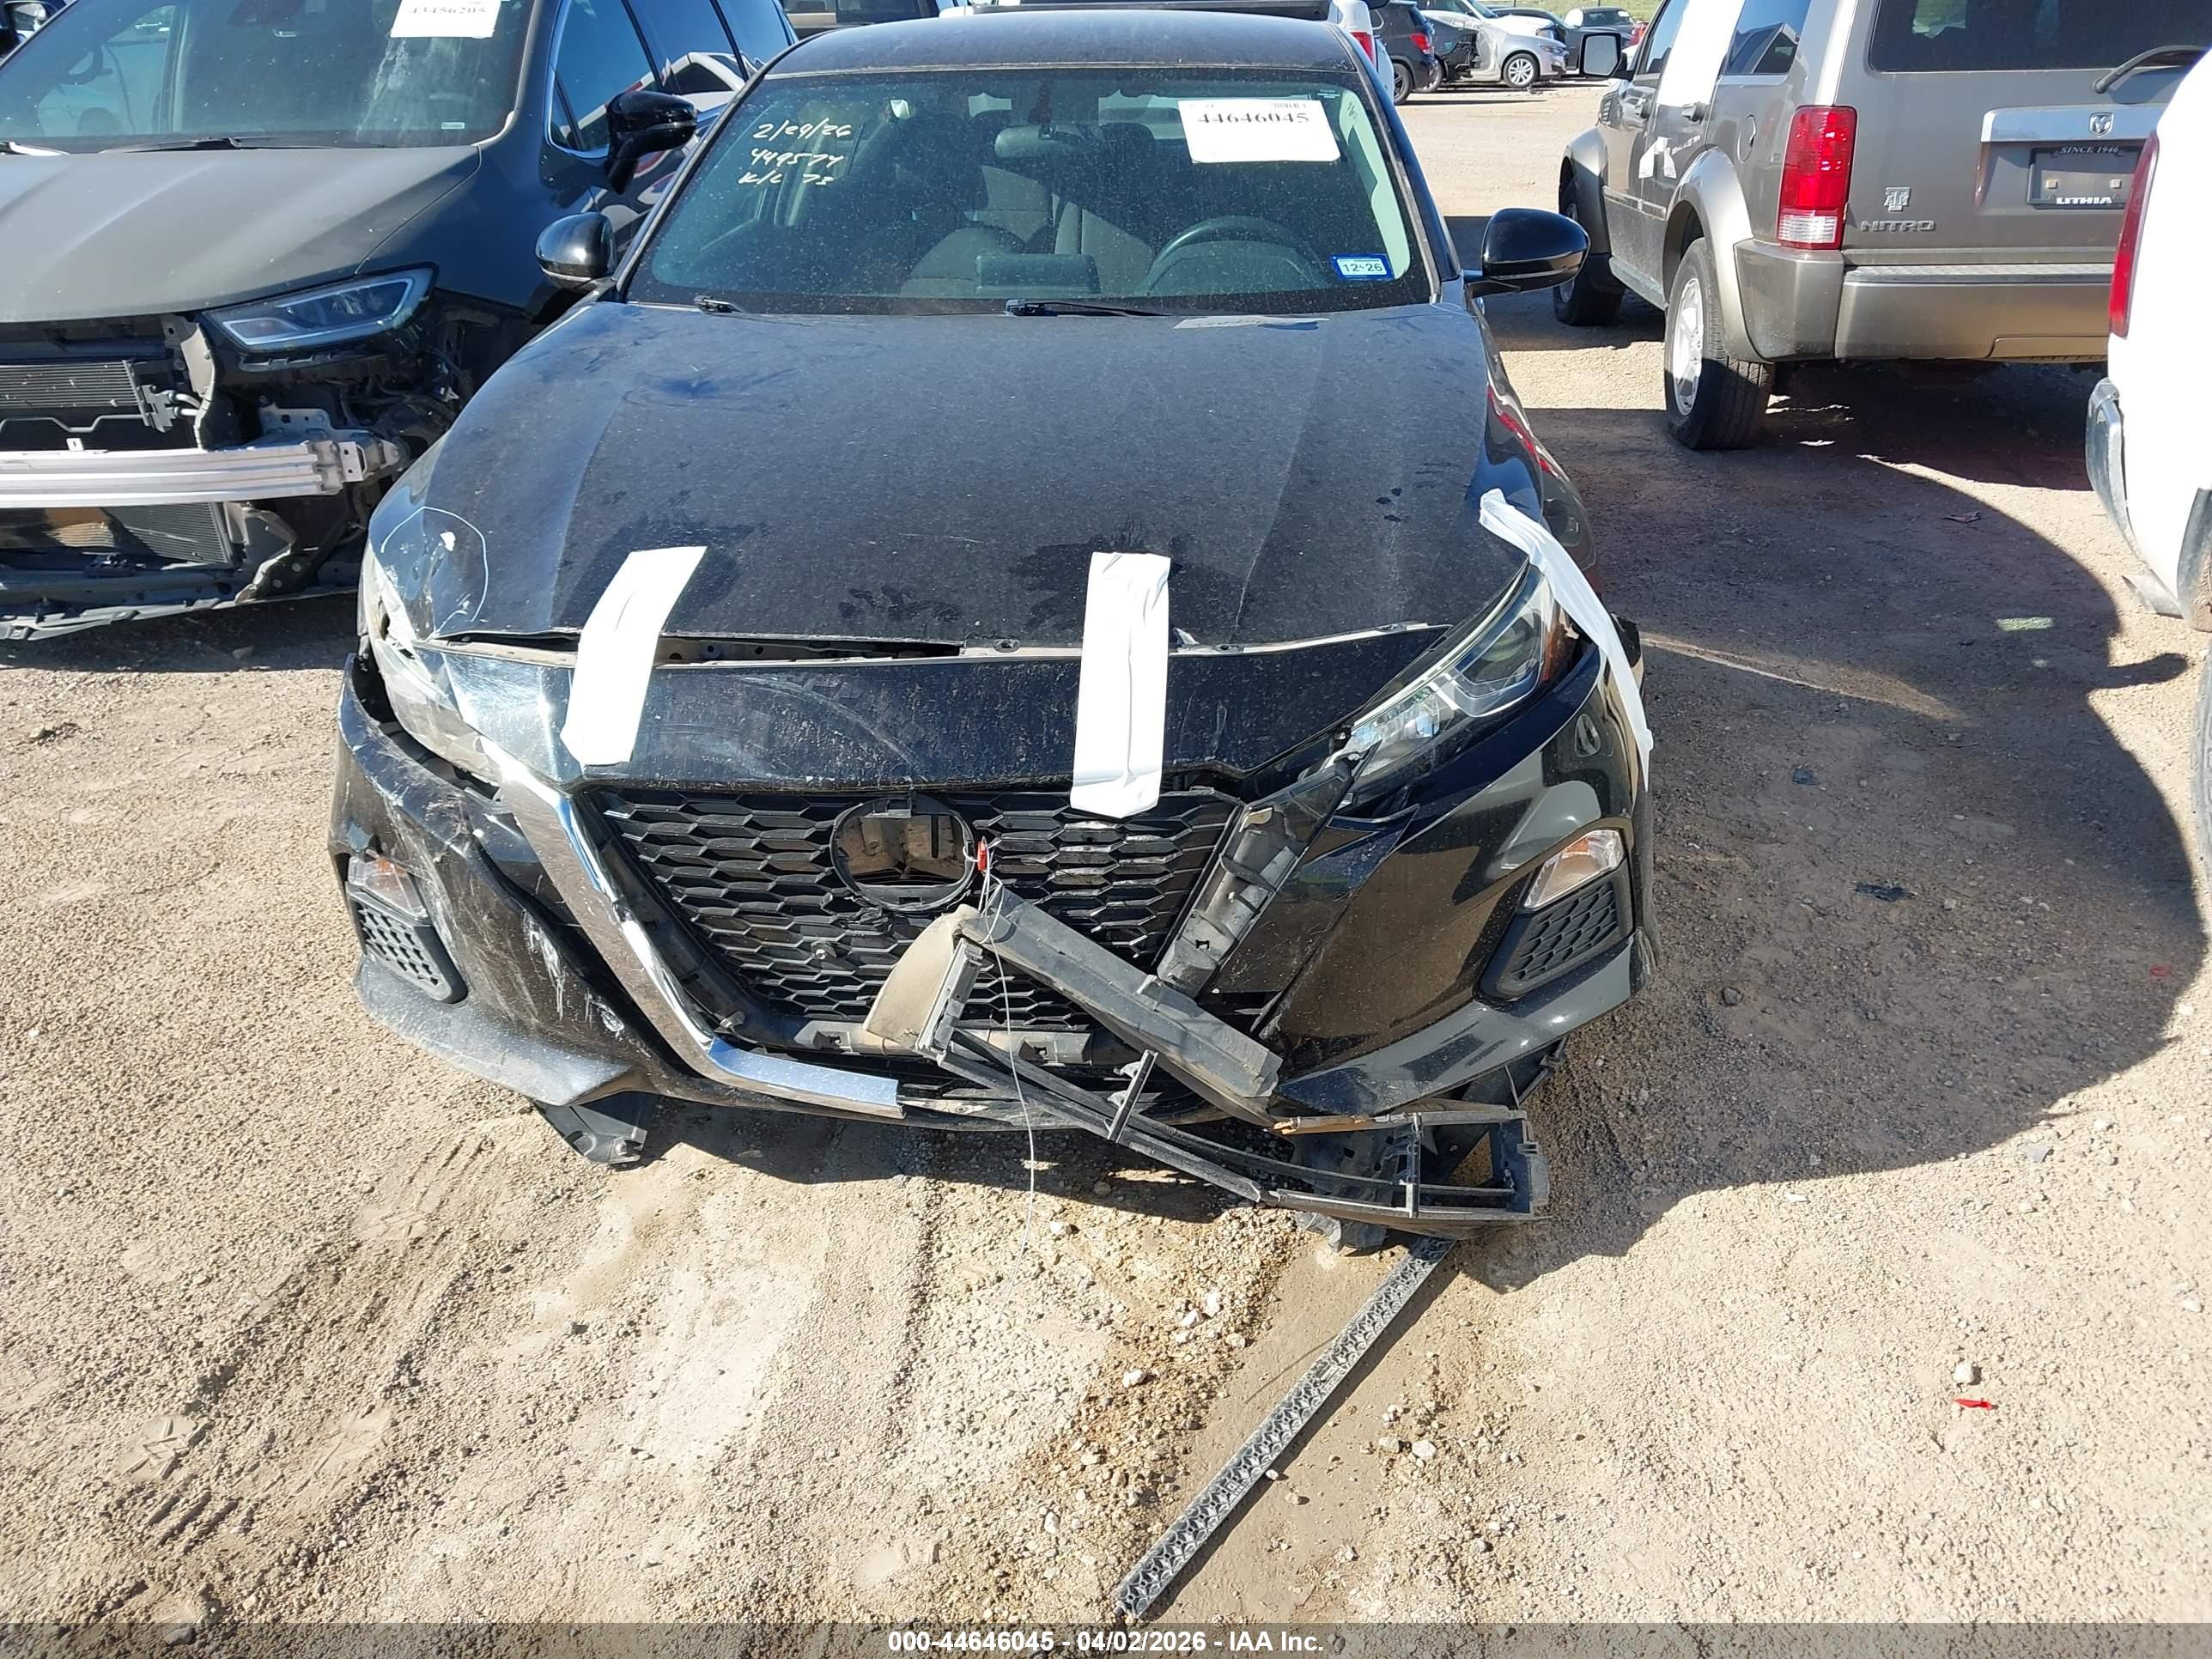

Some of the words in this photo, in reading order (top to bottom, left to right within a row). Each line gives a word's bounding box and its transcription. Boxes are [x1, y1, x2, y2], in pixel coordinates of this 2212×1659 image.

[1198, 112, 1310, 124] 44646045
[2060, 145, 2094, 154] SINCE
[2096, 145, 2119, 154] 1946
[2056, 197, 2113, 205] LITHIA
[1860, 220, 1936, 232] NITRO
